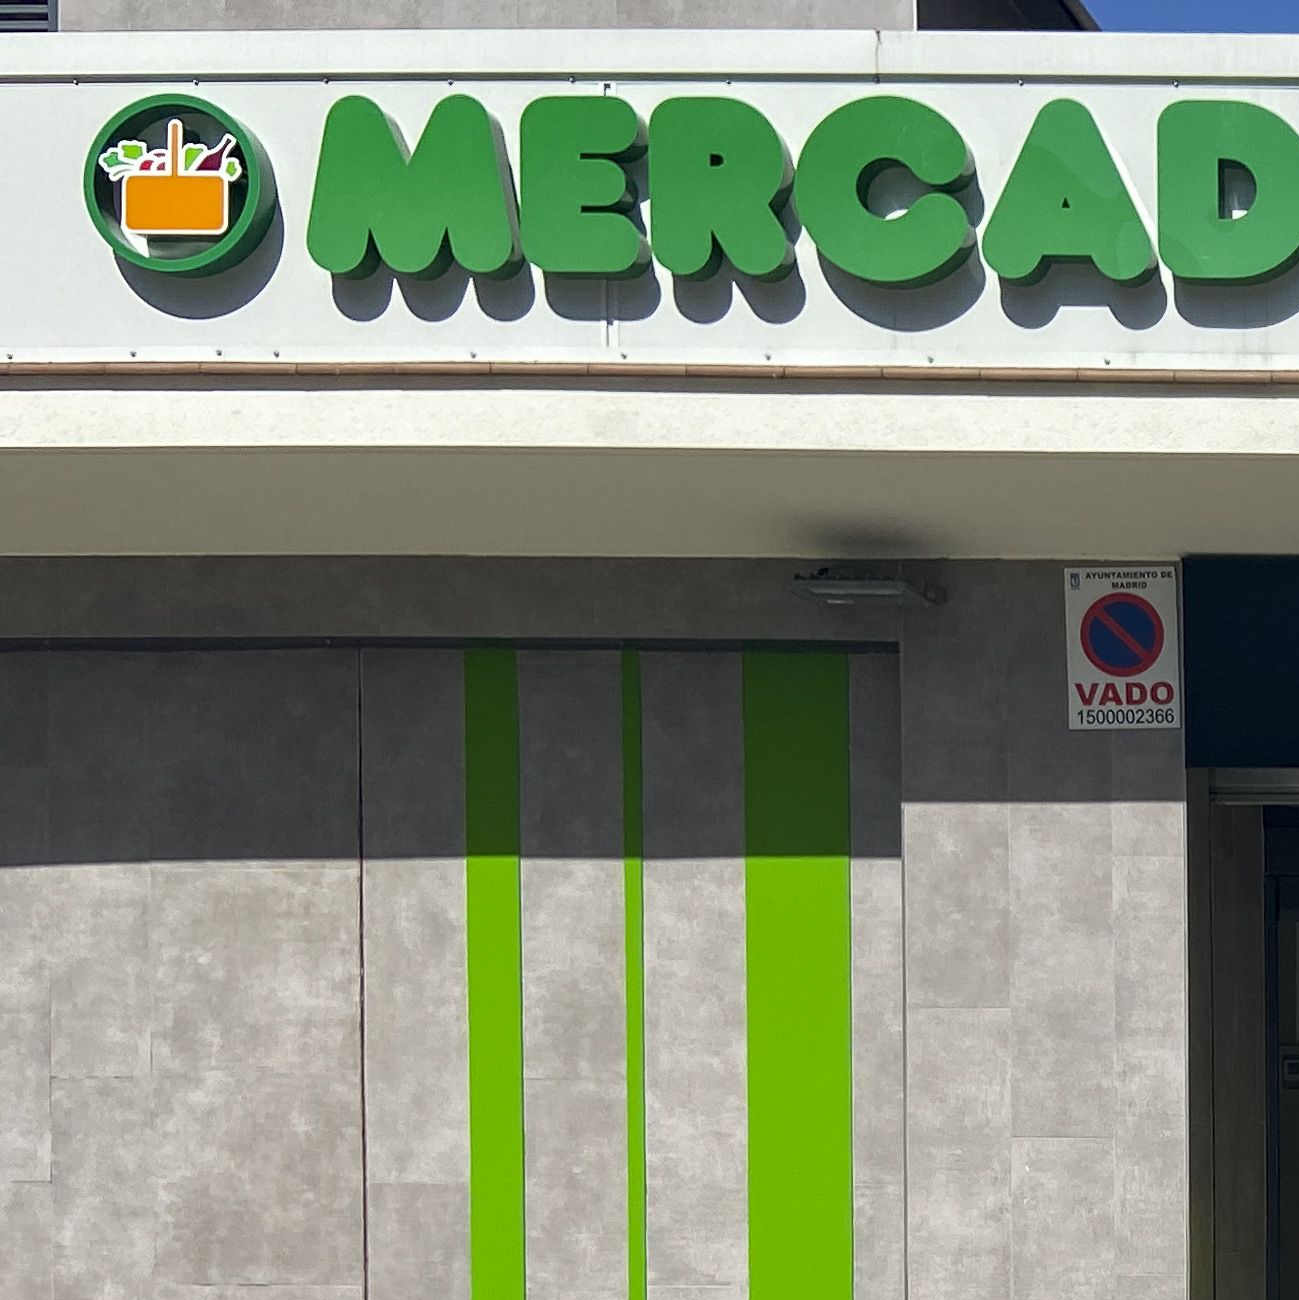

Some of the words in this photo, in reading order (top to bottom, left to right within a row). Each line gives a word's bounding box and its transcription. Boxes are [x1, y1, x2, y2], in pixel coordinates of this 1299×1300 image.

[1085, 571, 1158, 580] AYUNTAMIENTO
[1160, 571, 1174, 579] DE
[1111, 581, 1148, 590] MADRID
[1074, 681, 1175, 706] VADO
[1077, 708, 1175, 725] 1500002366
